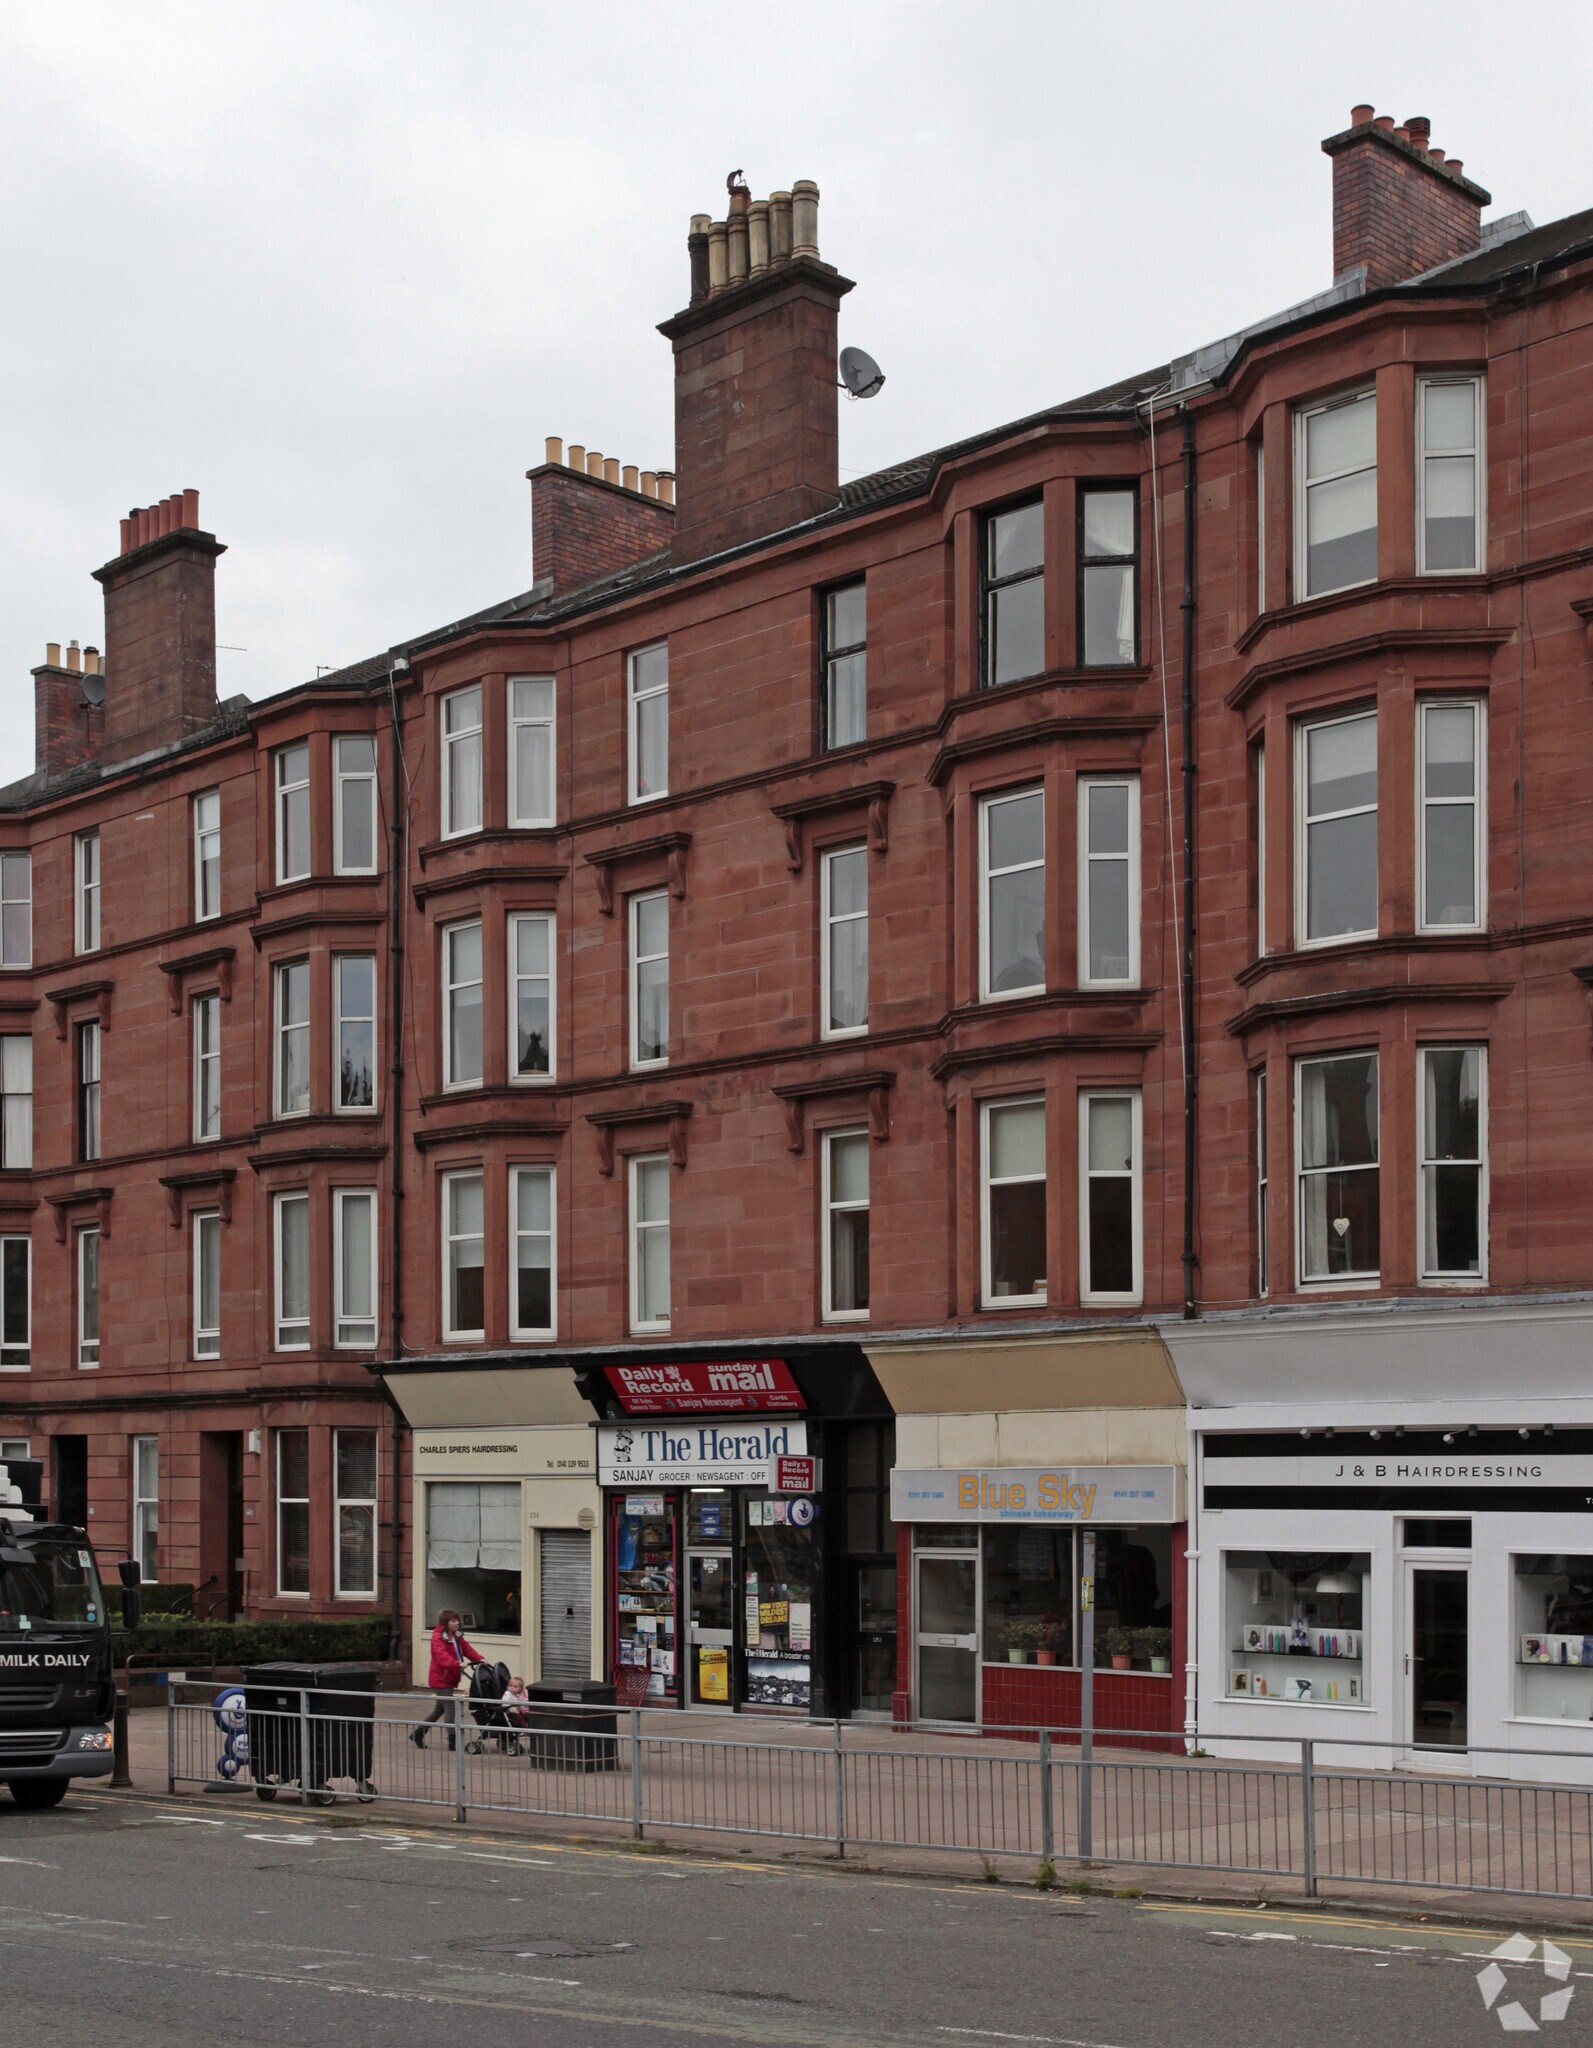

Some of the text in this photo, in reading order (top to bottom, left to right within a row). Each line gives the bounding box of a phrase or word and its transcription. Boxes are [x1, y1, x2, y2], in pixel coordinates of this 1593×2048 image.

[617, 1366, 665, 1383] Daily
[706, 1363, 757, 1375] sunday
[708, 1364, 776, 1391] mail
[624, 1379, 694, 1394] Record
[676, 1397, 744, 1409] Sanjay Newsagent
[419, 1445, 518, 1454] CHARLES SPIERS HAIRDRESSING
[641, 1427, 789, 1462] The Herald
[567, 1460, 577, 1468] 339
[782, 1460, 801, 1469] Daily
[612, 1469, 654, 1482] SANJAY
[658, 1472, 690, 1481] GROCER
[696, 1471, 745, 1481] NEWSAGENT
[750, 1471, 766, 1481] OFF
[1335, 1465, 1542, 1477] J & B HAIRDRESSING
[782, 1477, 809, 1489] mail
[957, 1474, 1098, 1519] Blue Sky
[999, 1509, 1074, 1520] chinese takeaway
[759, 1608, 788, 1617] WILDEST
[760, 1615, 788, 1625] DREAMS
[744, 1648, 757, 1657] The
[759, 1649, 779, 1659] Herald
[0, 1655, 90, 1667] MILK DAILY
[73, 1689, 97, 1698] LF
